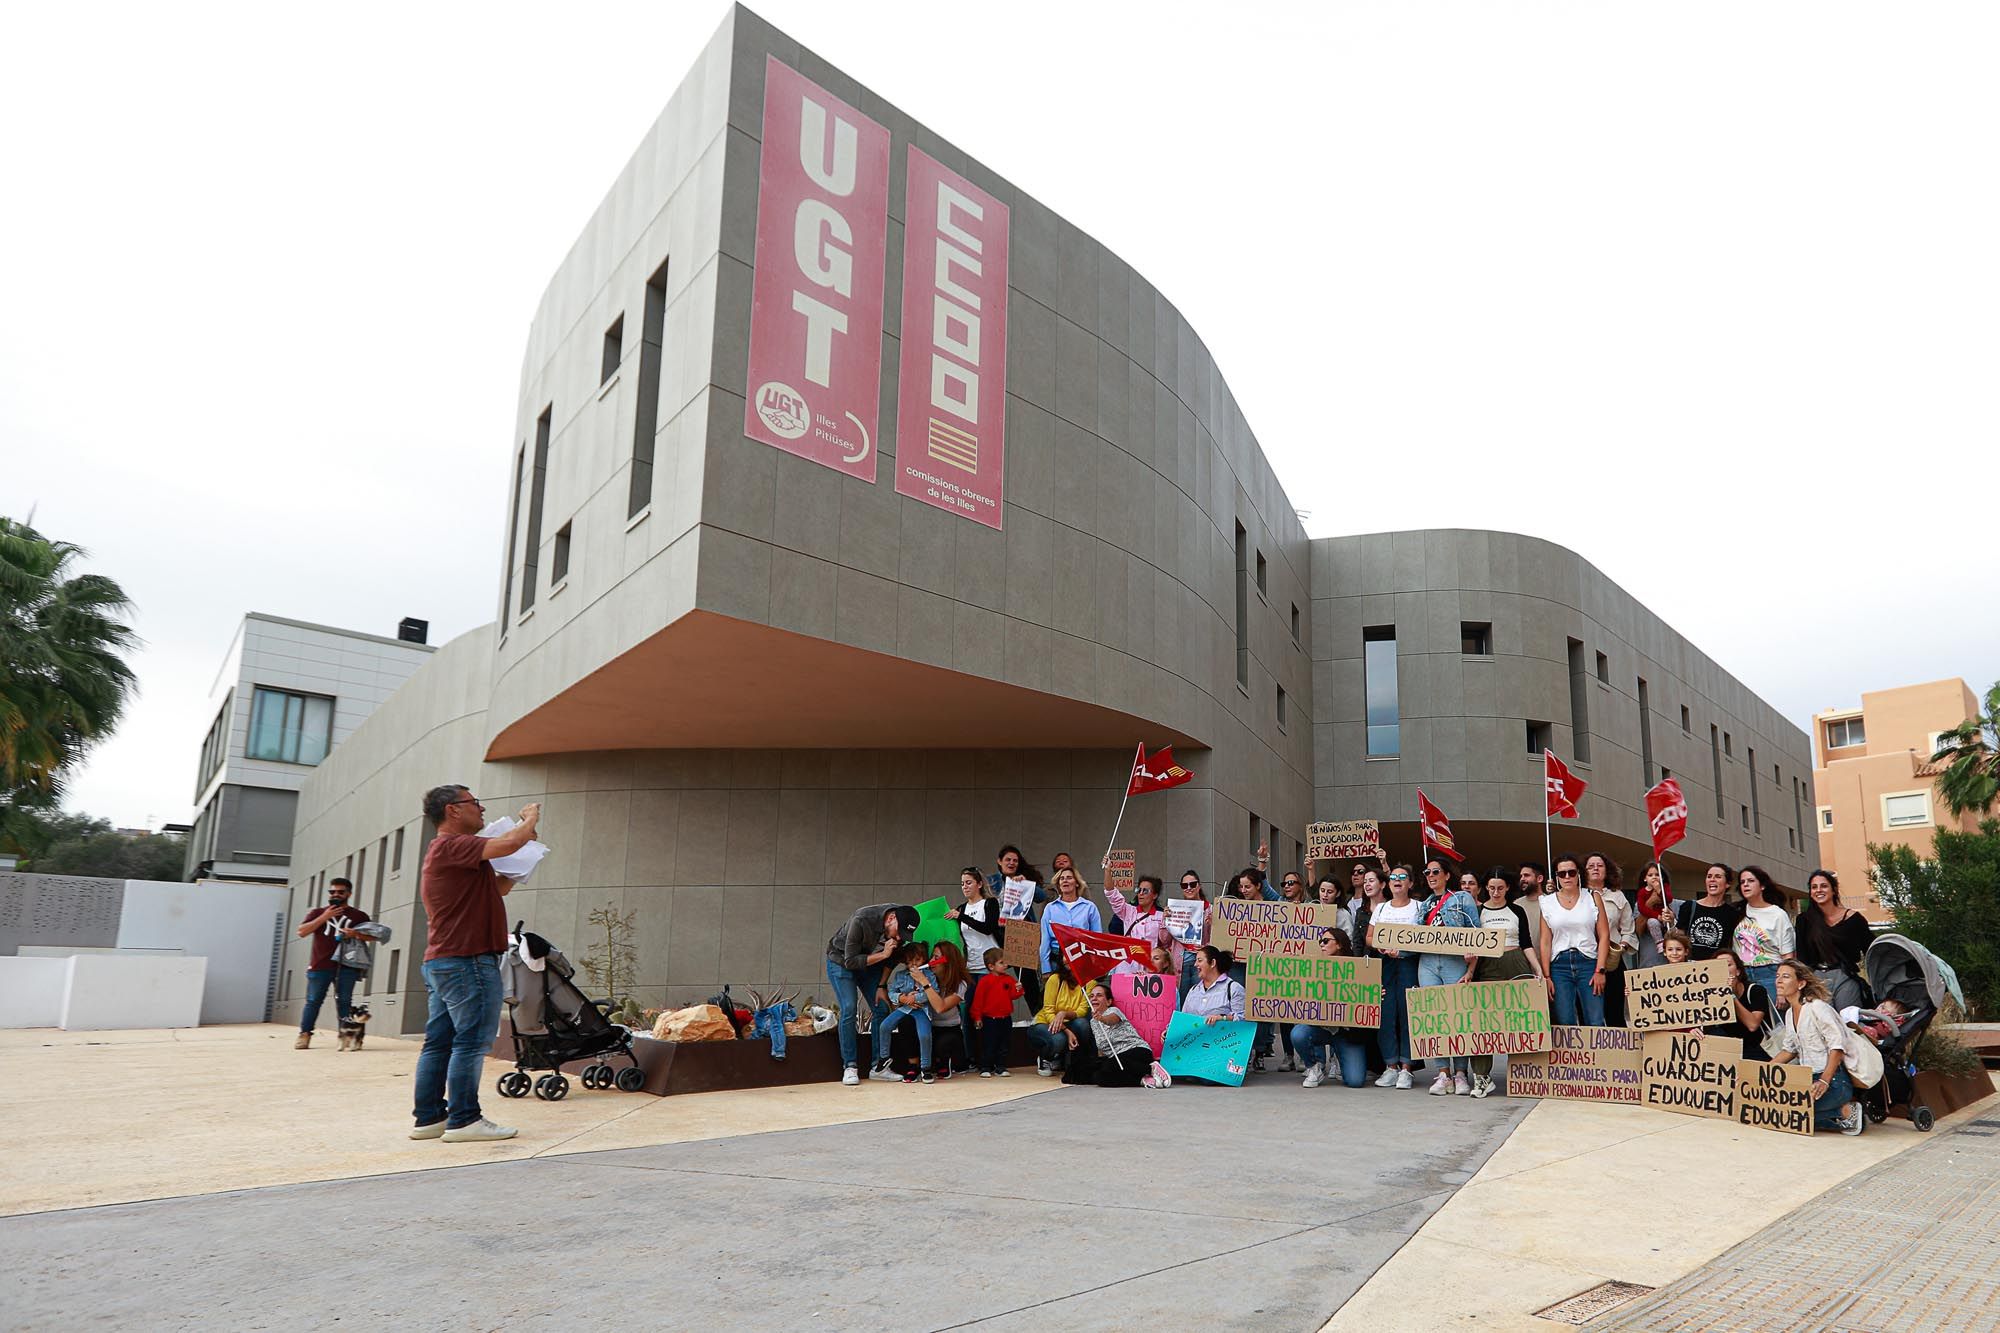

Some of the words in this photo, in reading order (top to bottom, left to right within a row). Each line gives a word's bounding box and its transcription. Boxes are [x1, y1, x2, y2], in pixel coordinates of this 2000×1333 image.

[792, 96, 858, 389] UGT
[930, 180, 984, 425] CCOO
[762, 387, 804, 421] UGT
[815, 413, 838, 430] Illes
[815, 428, 855, 451] Pitiüses
[906, 466, 960, 493] comissions
[961, 487, 996, 508] obreres
[927, 486, 940, 498] de
[941, 493, 955, 505] les
[957, 496, 976, 512] Illes
[1355, 822, 1373, 831] PARA
[1364, 828, 1379, 844] NO
[1310, 846, 1321, 858] ES
[1219, 901, 1288, 924] NOSALTRES
[1294, 906, 1315, 926] NO
[1247, 953, 1262, 976] LA
[1265, 957, 1312, 978] NOSTRA
[1315, 959, 1355, 981] FEINA
[1132, 974, 1164, 998] NO
[1640, 992, 1662, 1010] NO
[1682, 986, 1733, 1006] despesa
[1251, 996, 1347, 1023] RESPONSABILITAT
[1354, 1004, 1380, 1027] CURA
[1652, 999, 1731, 1025] INVERSIÓ
[1413, 1036, 1443, 1058] VIURE
[1448, 1033, 1466, 1056] NO
[1670, 1035, 1701, 1062] NO
[1548, 1065, 1607, 1083] RAZONABLES
[1612, 1069, 1638, 1084] PARA
[1643, 1057, 1737, 1089] GUARDEM
[1758, 1064, 1787, 1088] NO
[1509, 1080, 1549, 1096] EDUCACIÓN
[1552, 1082, 1605, 1099] PERSONALIZADA
[1613, 1086, 1623, 1101] DE
[1648, 1083, 1734, 1116] EDUQUEM
[1740, 1081, 1812, 1108] GUARDEM
[1740, 1103, 1811, 1134] EDUQUEM
